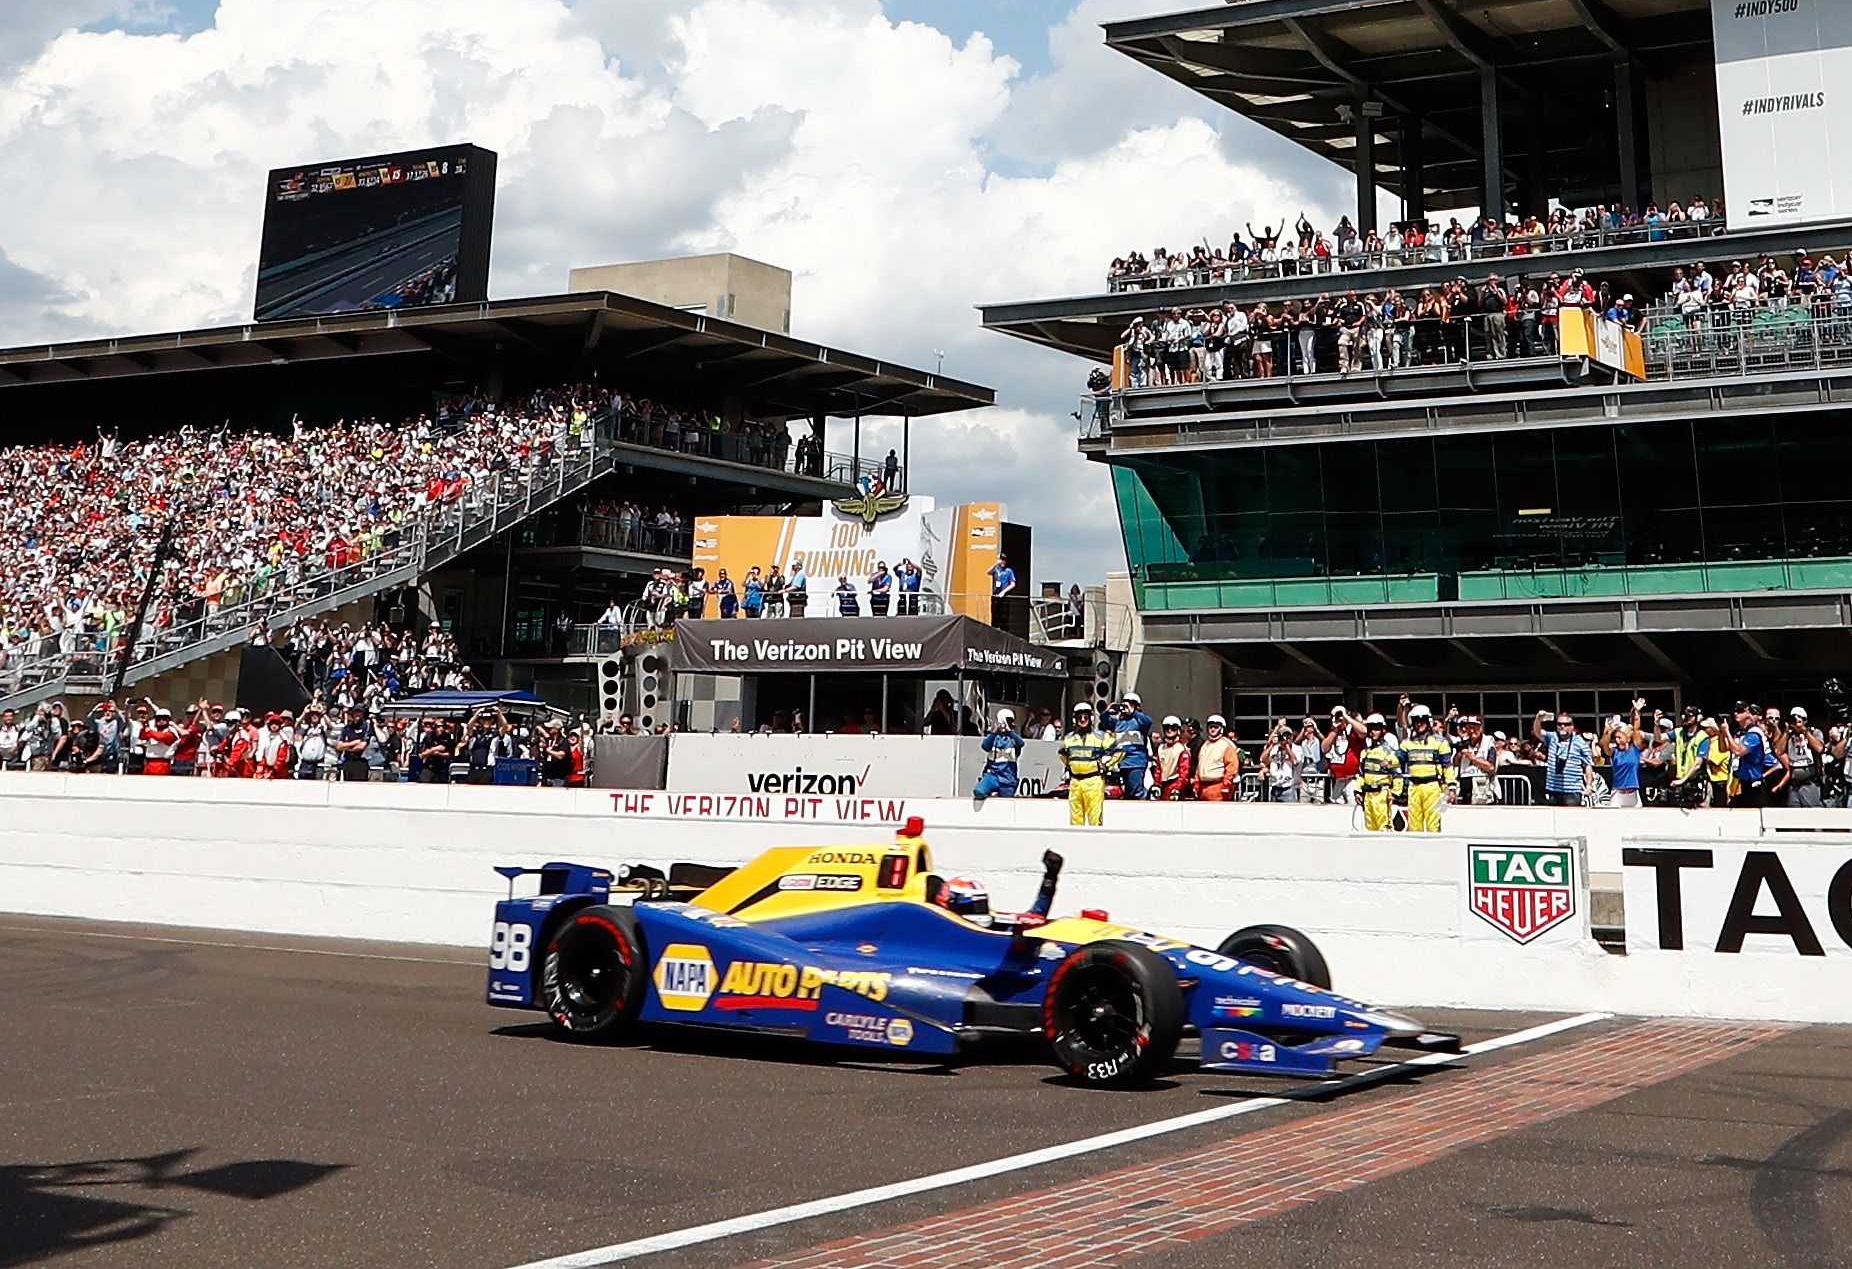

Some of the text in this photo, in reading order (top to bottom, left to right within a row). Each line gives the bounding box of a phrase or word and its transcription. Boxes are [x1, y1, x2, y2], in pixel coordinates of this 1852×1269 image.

[1742, 92, 1825, 116] #INDYRIVALS
[710, 638, 922, 661] The Verizon Pit View
[967, 648, 984, 663] The
[747, 766, 856, 794] verizon
[610, 793, 654, 814] THE
[785, 797, 823, 819] PIT
[836, 799, 905, 821] VIEW
[808, 853, 877, 865] HONDA
[1478, 853, 1563, 884] TAG
[816, 876, 861, 890] EDGE
[1476, 889, 1567, 935] HEUER
[490, 921, 533, 972] 98
[664, 961, 708, 994] NAPA
[719, 961, 798, 999] AUTO
